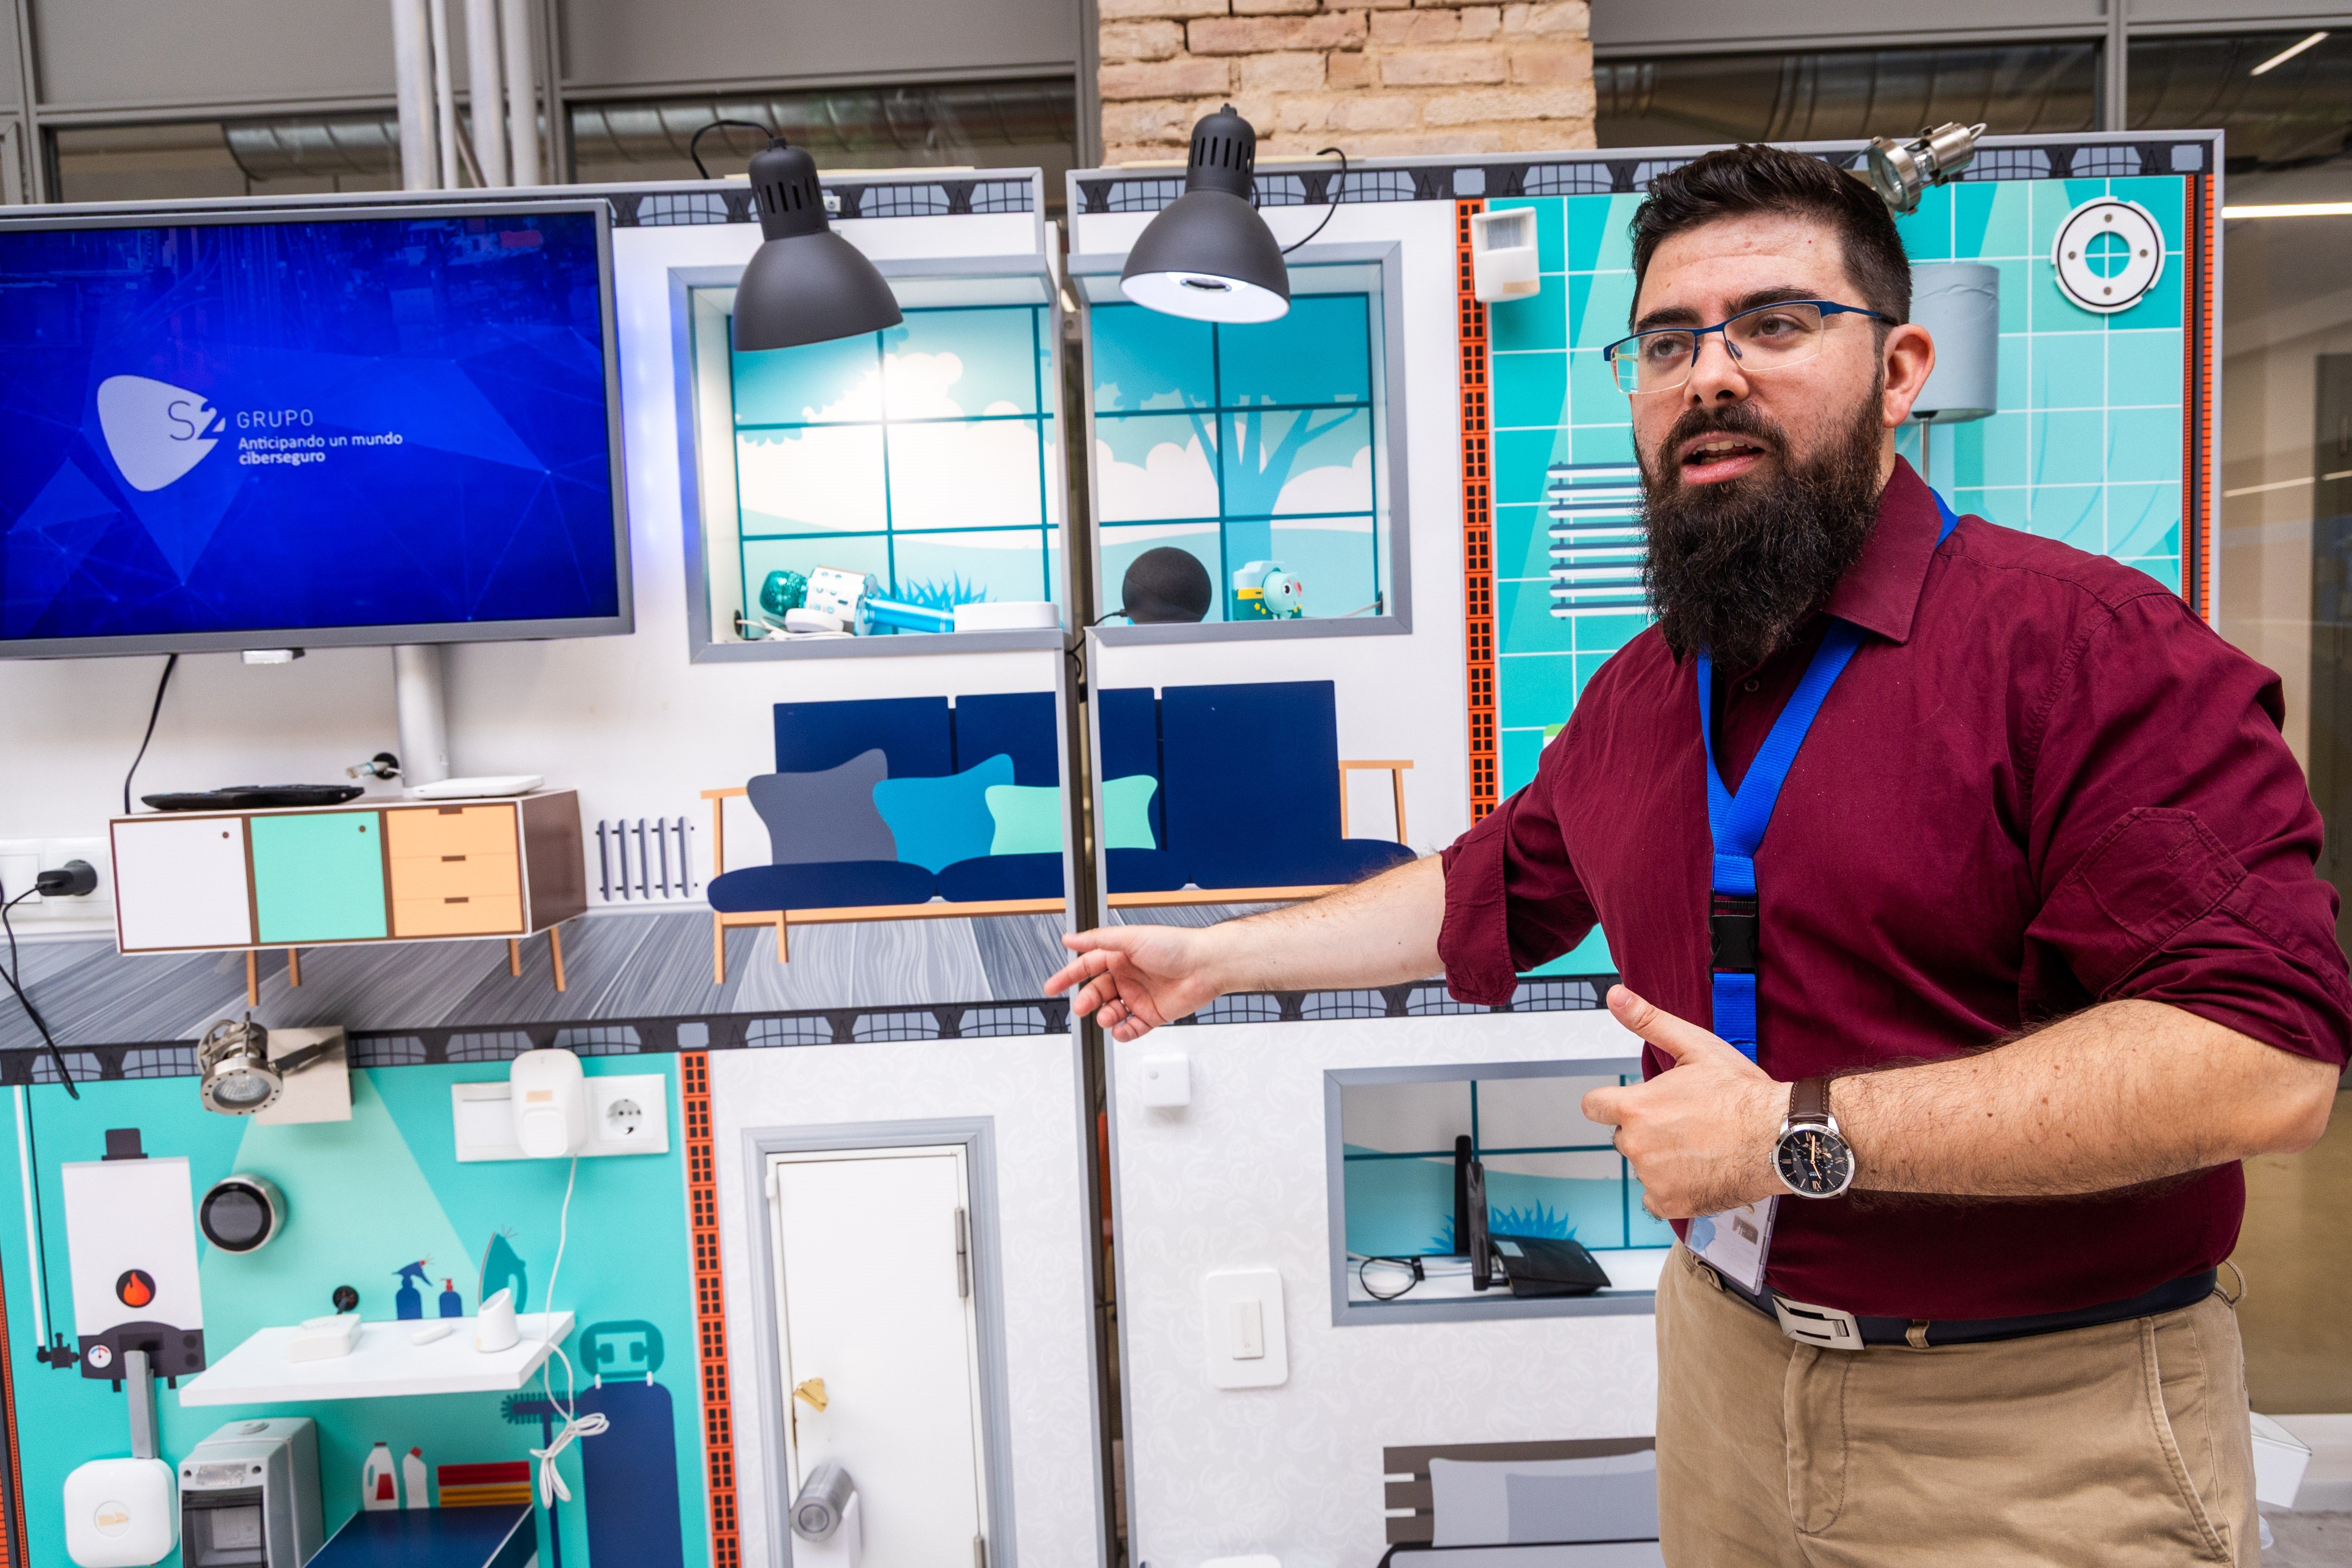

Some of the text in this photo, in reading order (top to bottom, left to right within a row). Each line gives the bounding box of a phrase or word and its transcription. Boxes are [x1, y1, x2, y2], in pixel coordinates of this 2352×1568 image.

[236, 408, 314, 429] GRUPO
[238, 431, 403, 451] Anticipando un mundo
[239, 451, 326, 466] ciberseguro
